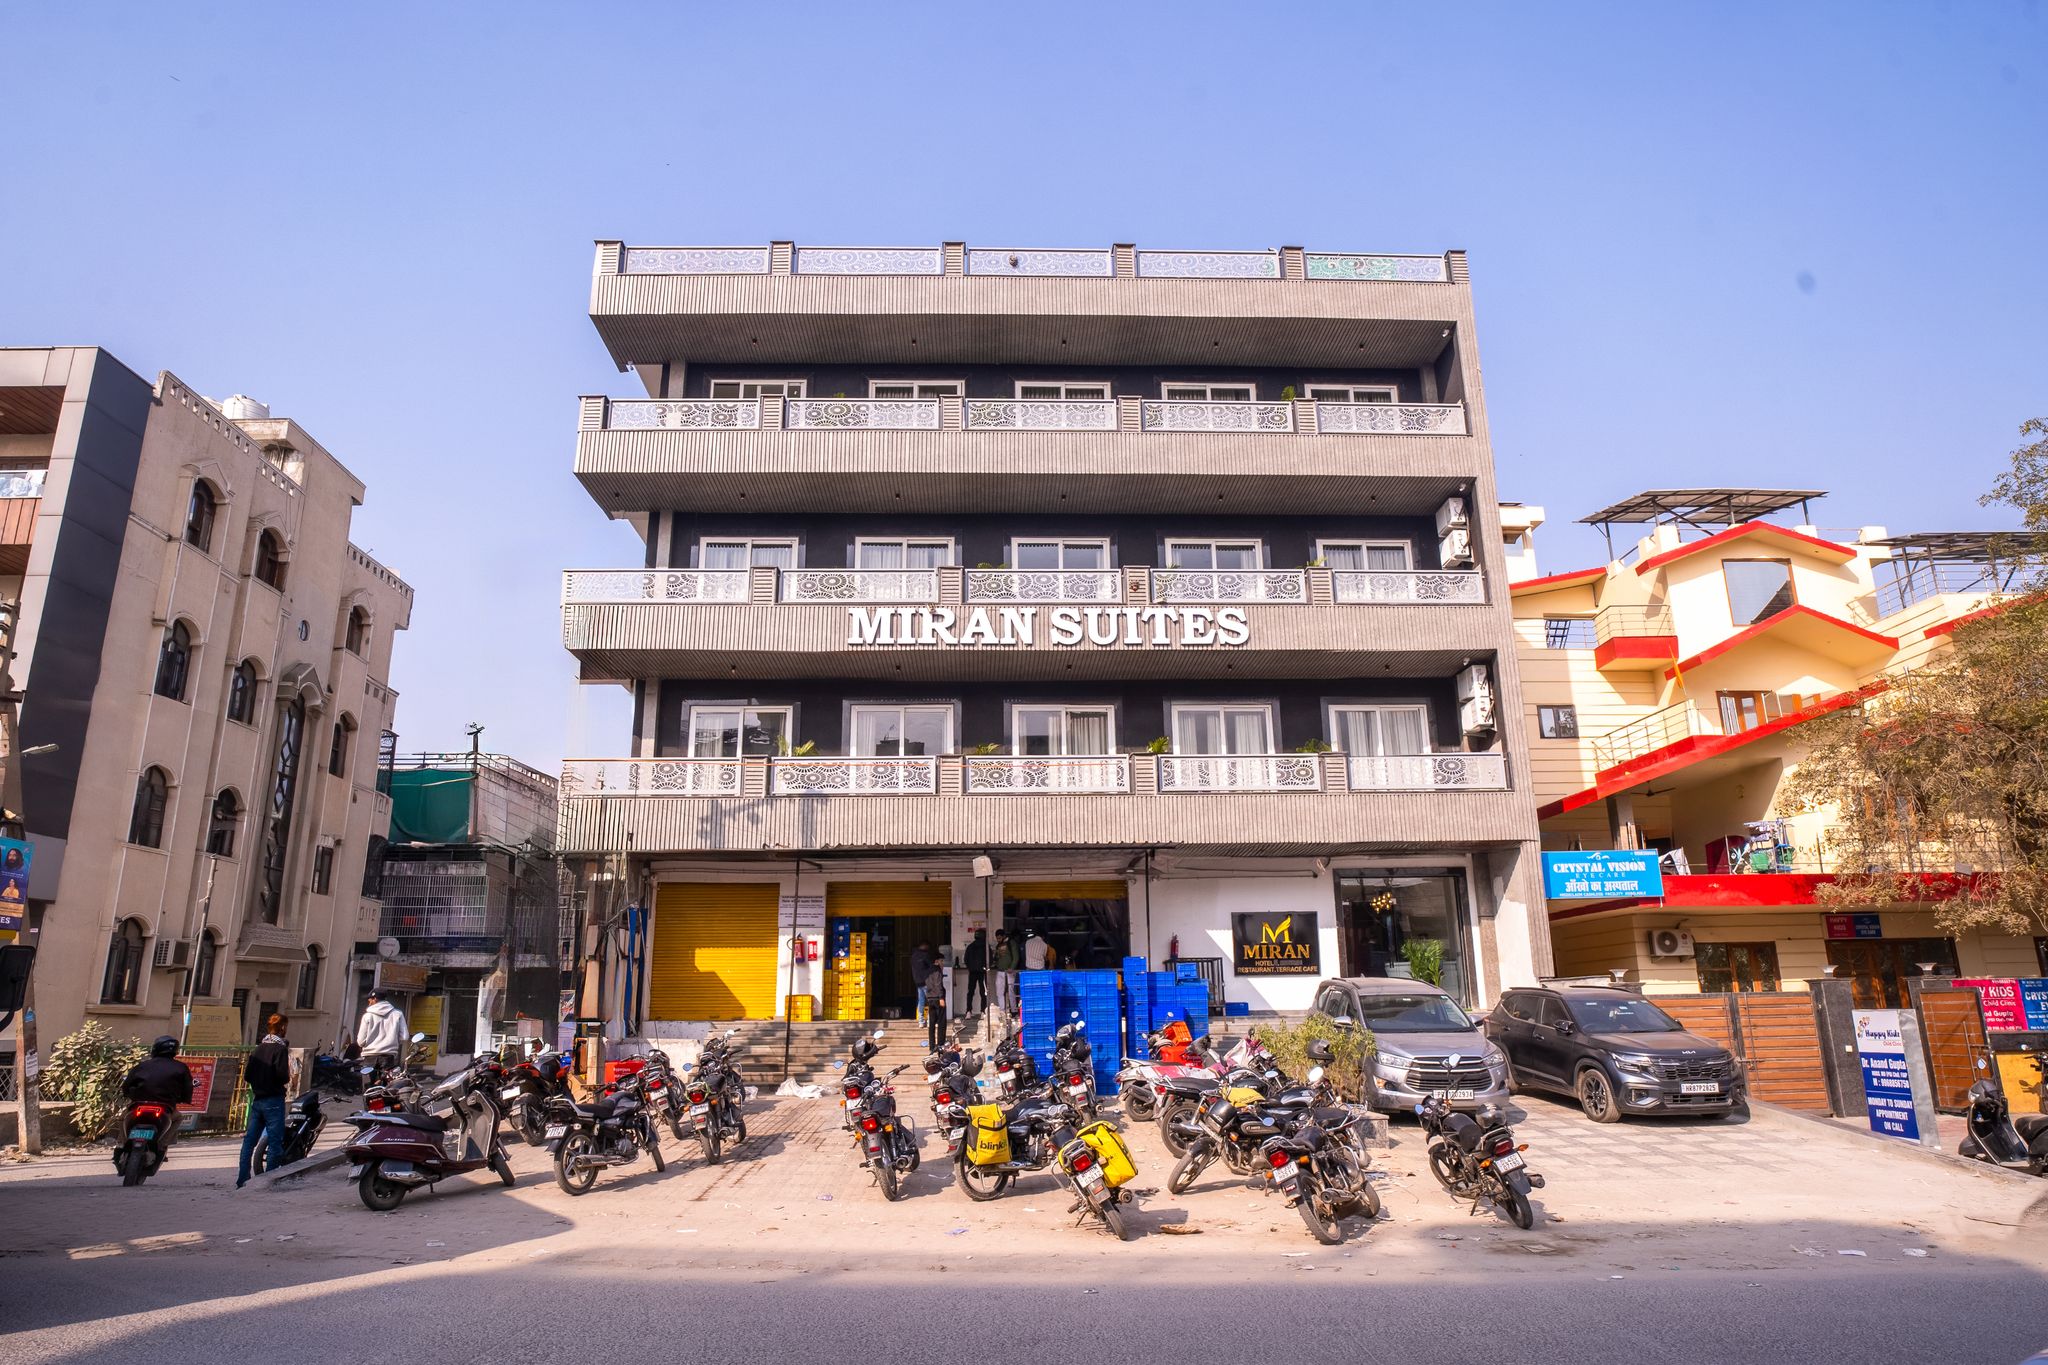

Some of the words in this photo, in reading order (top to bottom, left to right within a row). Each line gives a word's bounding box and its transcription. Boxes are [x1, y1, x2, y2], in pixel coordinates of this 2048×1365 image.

[847, 607, 1036, 645] MIRAN
[1050, 607, 1250, 646] SUITES
[1553, 862, 1605, 873] CRYSTAL
[1607, 861, 1646, 872] VISION
[1590, 880, 1601, 892] का
[1604, 880, 1638, 891] अस्पताल
[1243, 944, 1310, 959] MIRAN
[1988, 986, 2015, 997] KIDS
[1865, 1030, 1886, 1039] Happy
[1861, 1058, 1869, 1067] Dr.
[1870, 1058, 1888, 1068] Anand
[1888, 1059, 1906, 1070] Gupta
[1868, 1097, 1886, 1106] MONDAY
[1887, 1099, 1893, 1107] TO
[1894, 1099, 1912, 1109] SUNDAY
[1876, 1109, 1908, 1120] APPOINTMENT
[1884, 1121, 1891, 1130] ON
[1892, 1122, 1904, 1131] CALL
